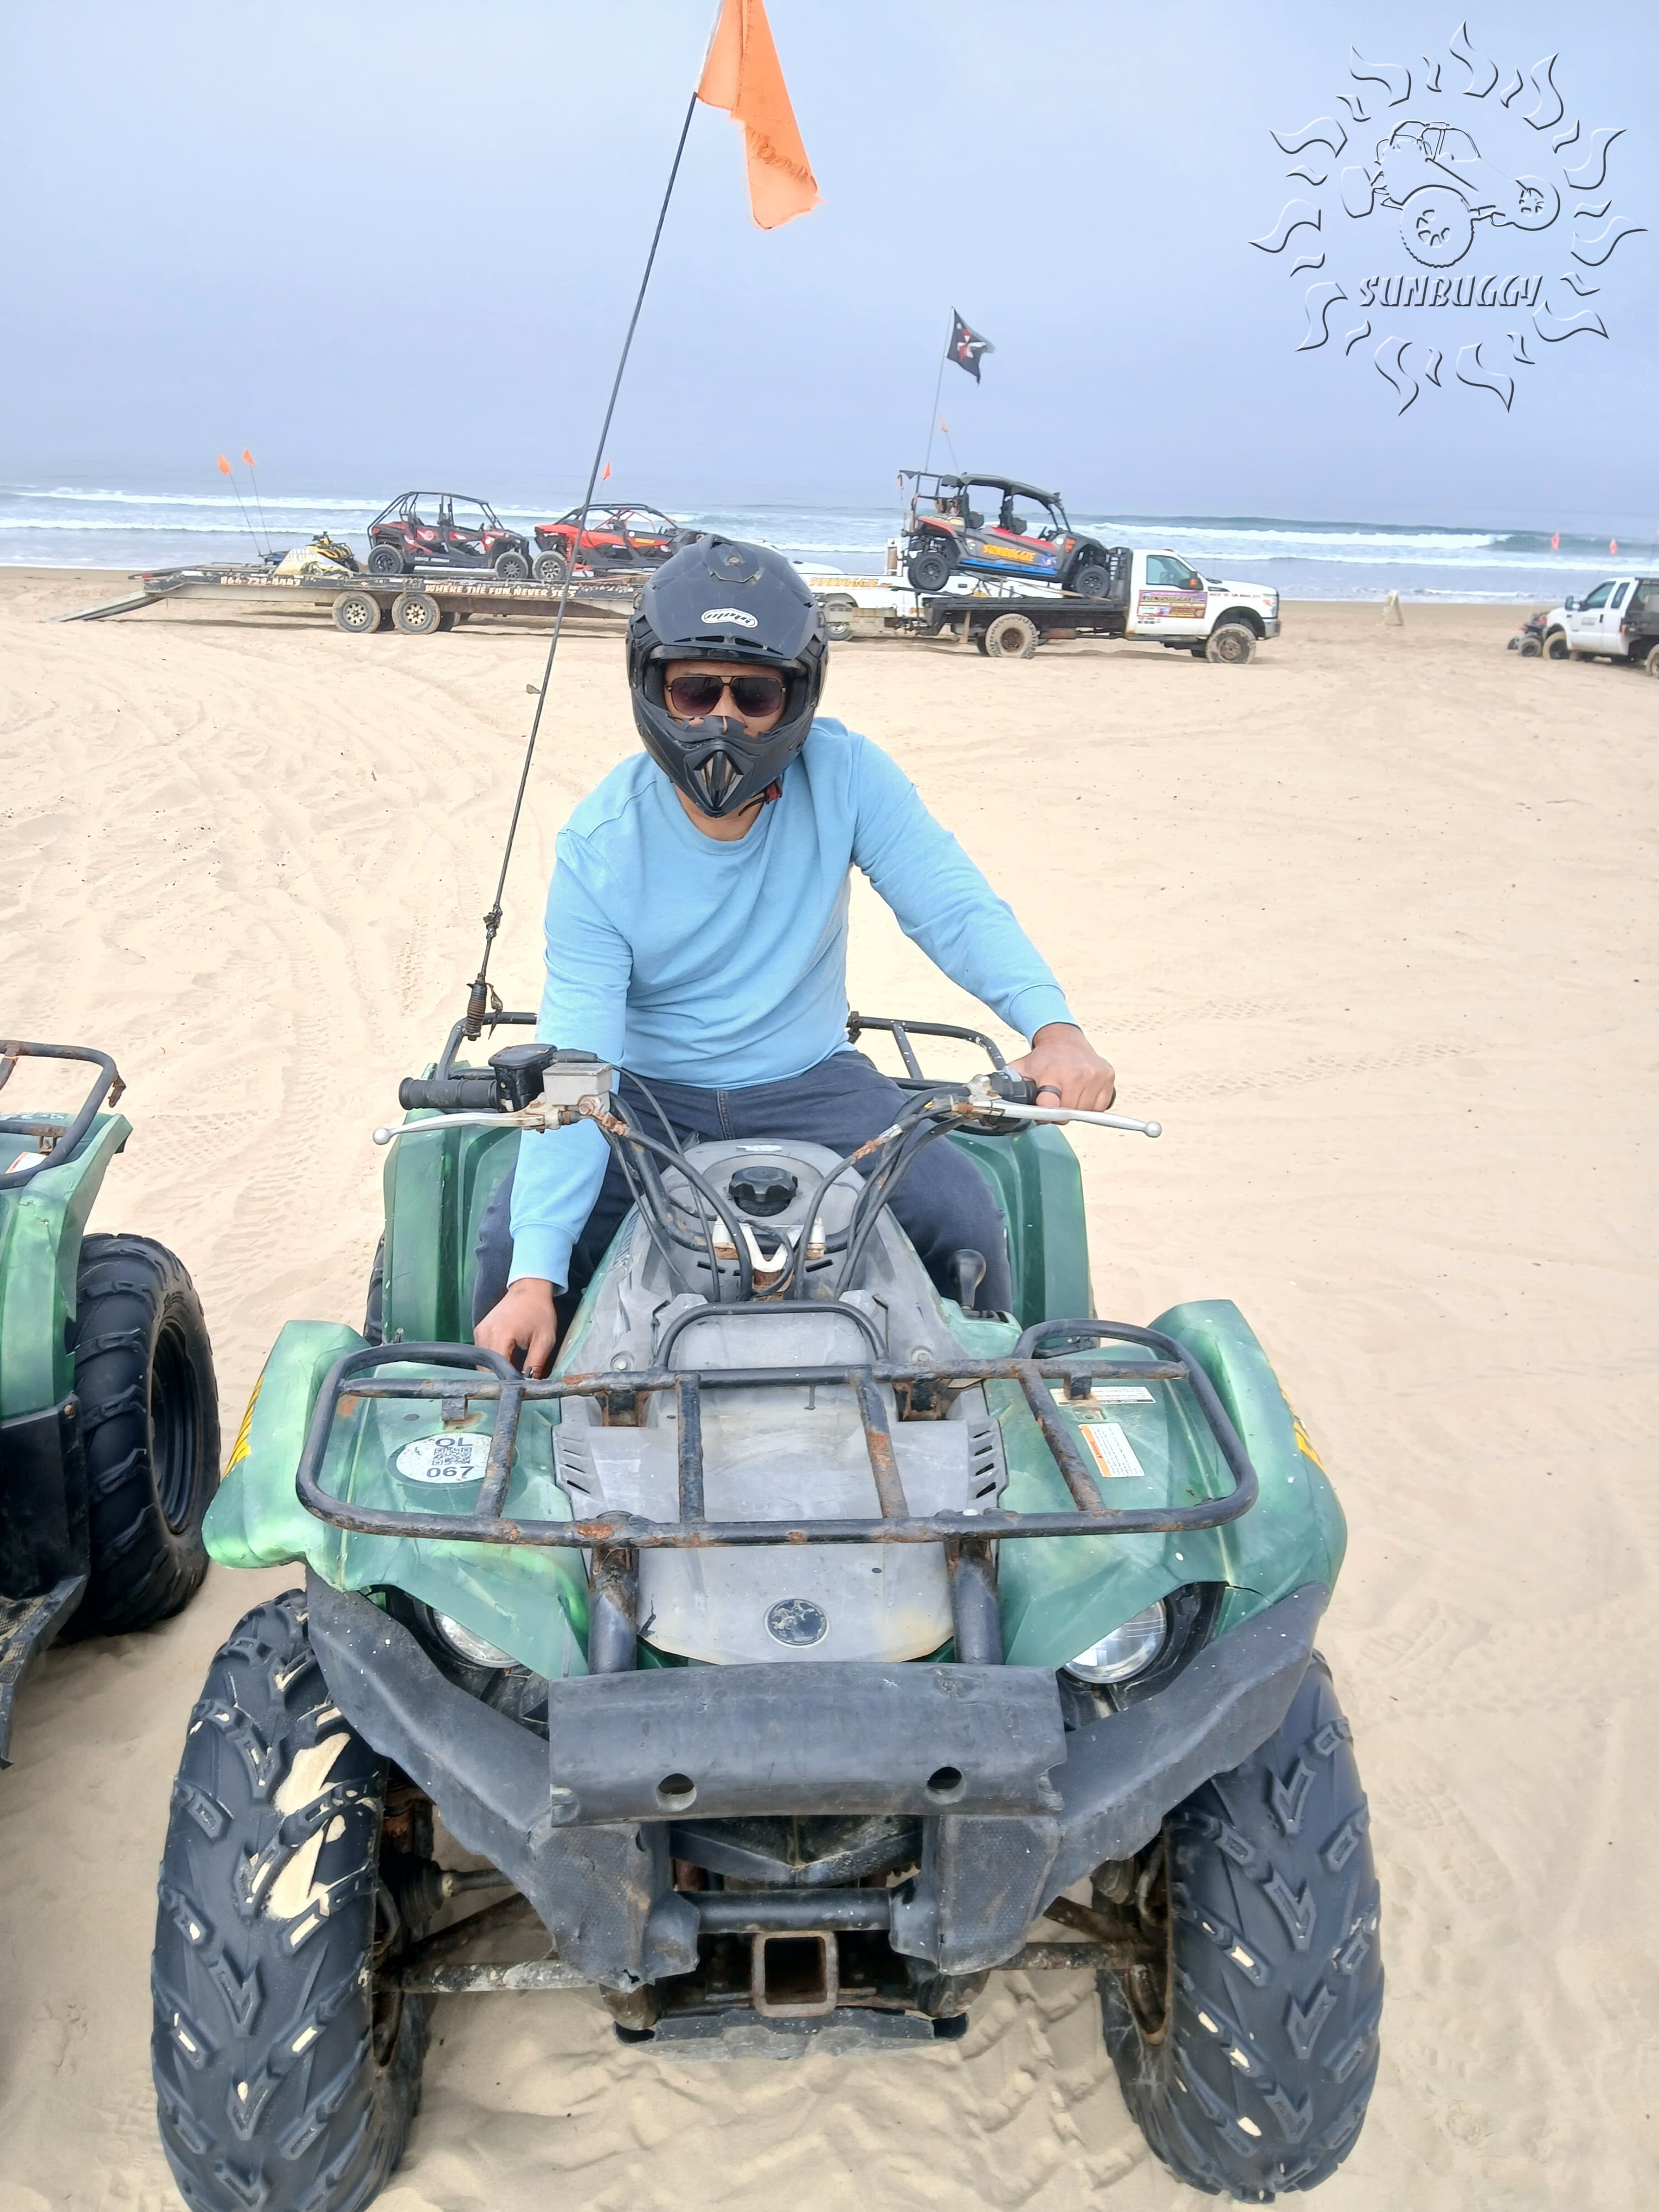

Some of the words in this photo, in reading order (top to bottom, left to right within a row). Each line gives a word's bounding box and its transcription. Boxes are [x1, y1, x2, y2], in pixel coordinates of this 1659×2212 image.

[425, 584, 464, 594] WHERE
[466, 586, 487, 595] THE
[513, 587, 549, 597] NEVER
[551, 589, 577, 598] SES
[426, 1465, 474, 1478] 067
